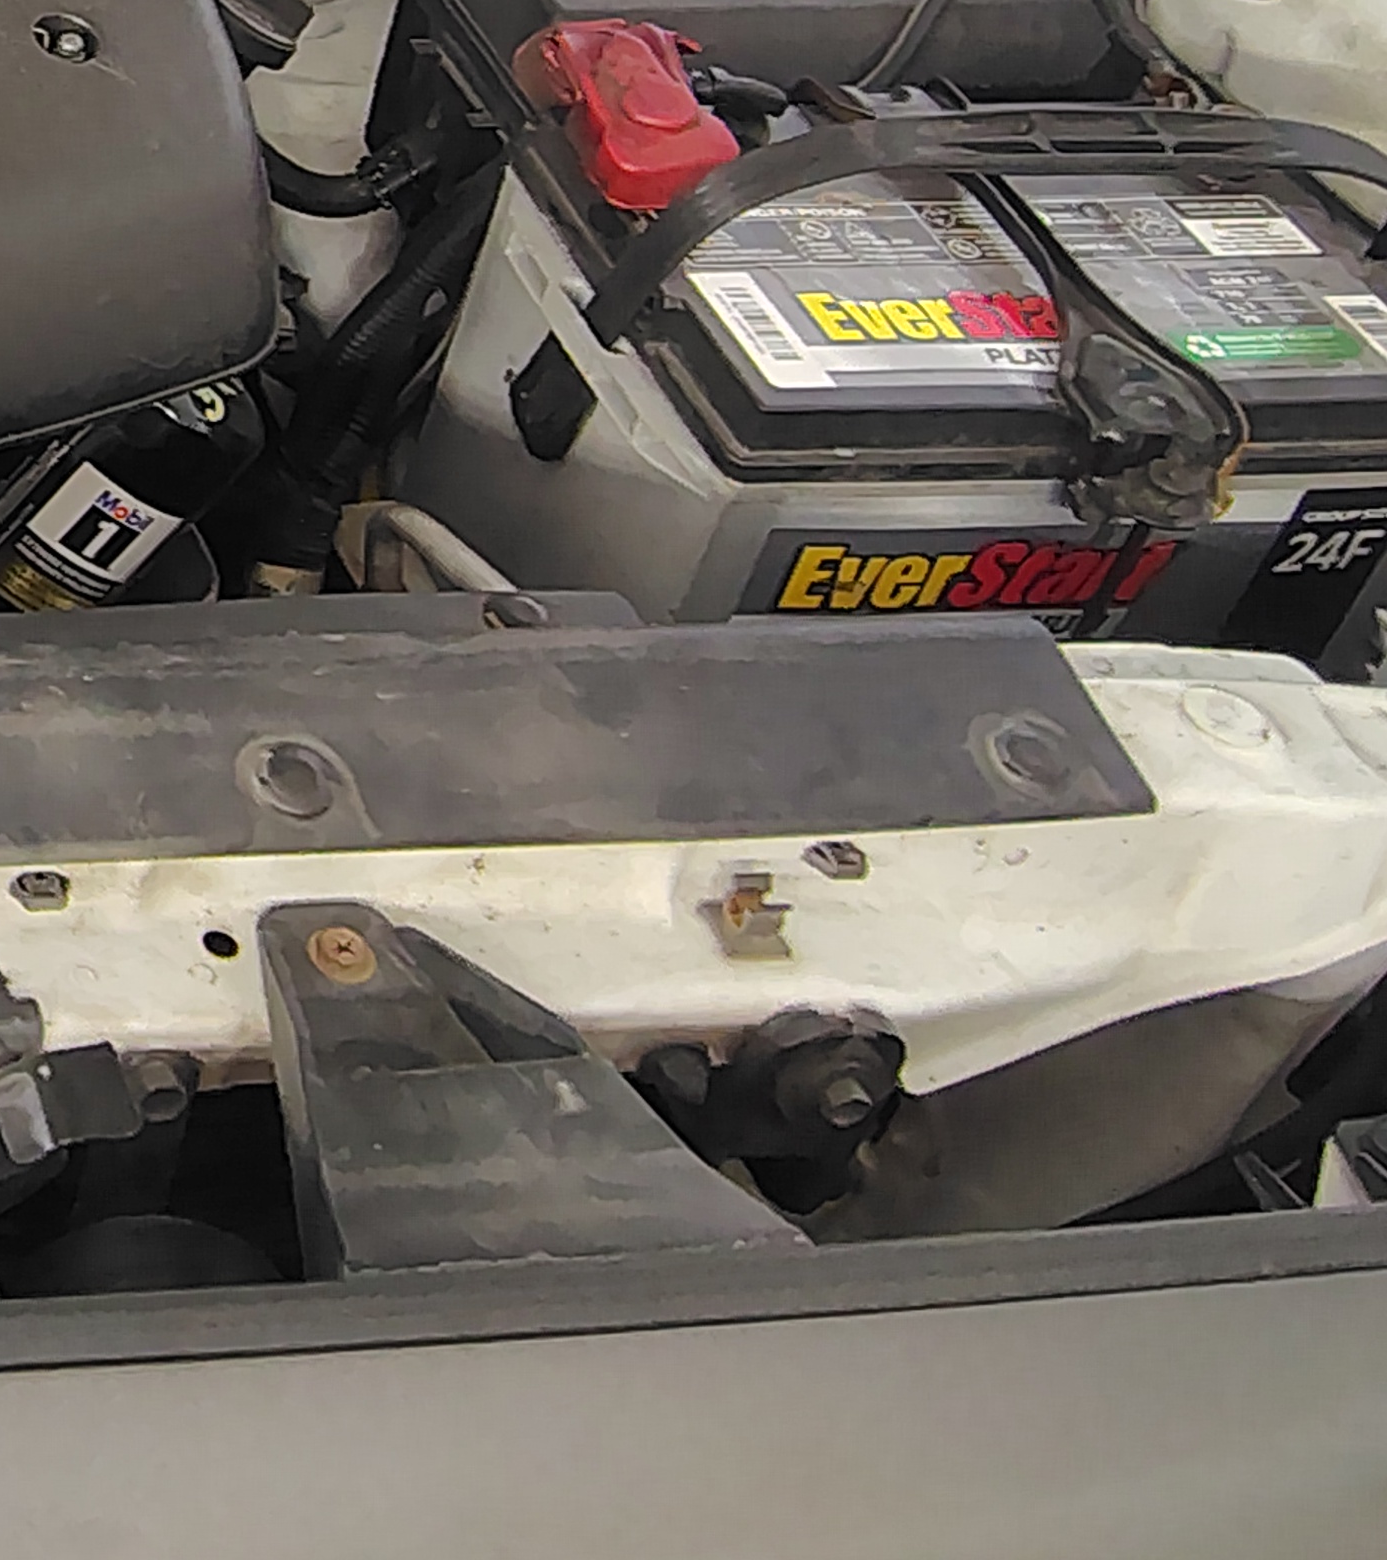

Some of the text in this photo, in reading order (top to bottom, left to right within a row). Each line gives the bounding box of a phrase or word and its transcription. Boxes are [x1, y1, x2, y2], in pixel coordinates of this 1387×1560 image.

[795, 289, 1060, 343] EverSta
[984, 347, 1061, 366] PLAT
[95, 490, 156, 531] Mobil
[80, 520, 121, 559] 1
[1271, 528, 1386, 574] 24F
